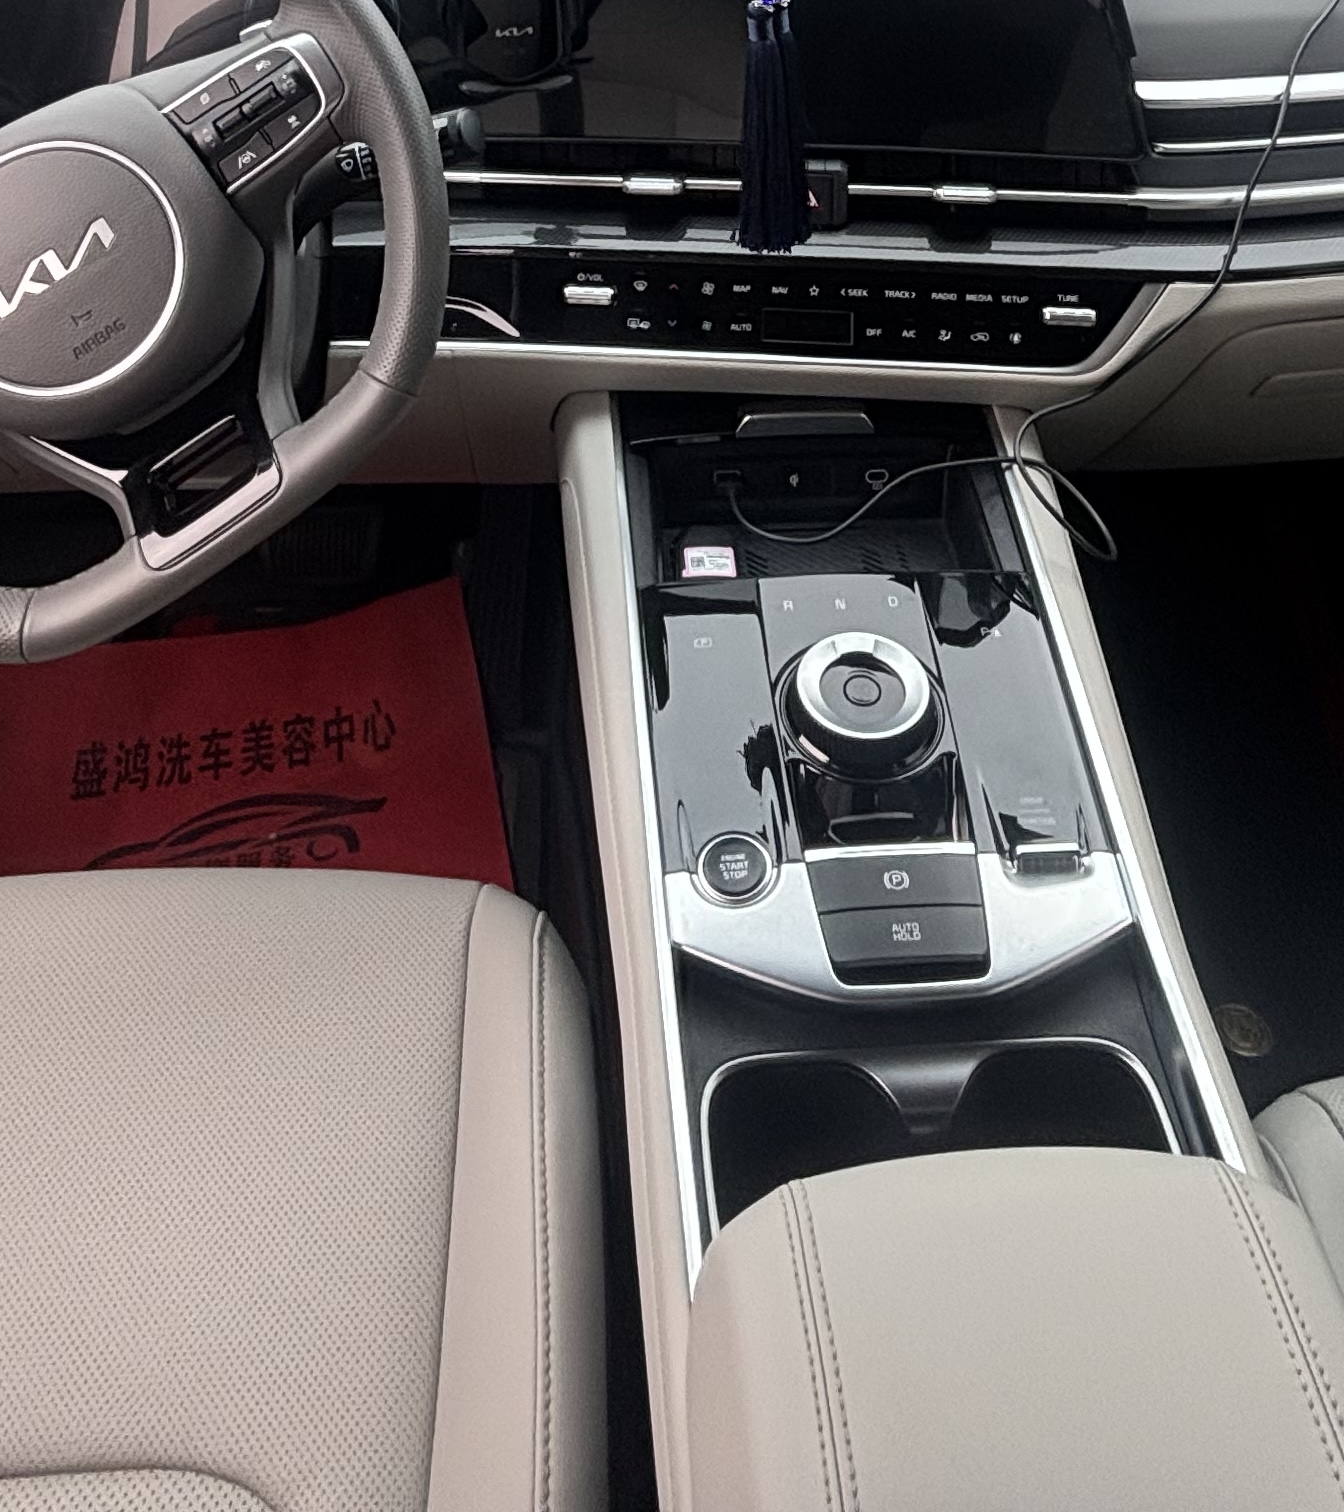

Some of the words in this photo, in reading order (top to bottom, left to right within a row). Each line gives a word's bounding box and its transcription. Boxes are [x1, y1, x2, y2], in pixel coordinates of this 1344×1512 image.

[732, 284, 752, 293] MAP
[771, 286, 788, 295] NAV
[931, 292, 957, 301] RADIO
[965, 293, 993, 303] MEDIA
[1001, 295, 1029, 304] SETUP
[1057, 293, 1079, 303] TUNE
[730, 322, 752, 332] AUTO
[865, 327, 882, 337] OFF
[72, 317, 127, 360] AIRBAG
[901, 329, 917, 339] A/C
[783, 600, 794, 611] R
[834, 598, 846, 610] N
[887, 596, 899, 607] D
[70, 699, 398, 801] 盛鸿洗车美容中心
[719, 861, 748, 871] START
[723, 870, 748, 880] STOP
[892, 922, 919, 933] AUTO
[893, 931, 921, 941] HOLD
